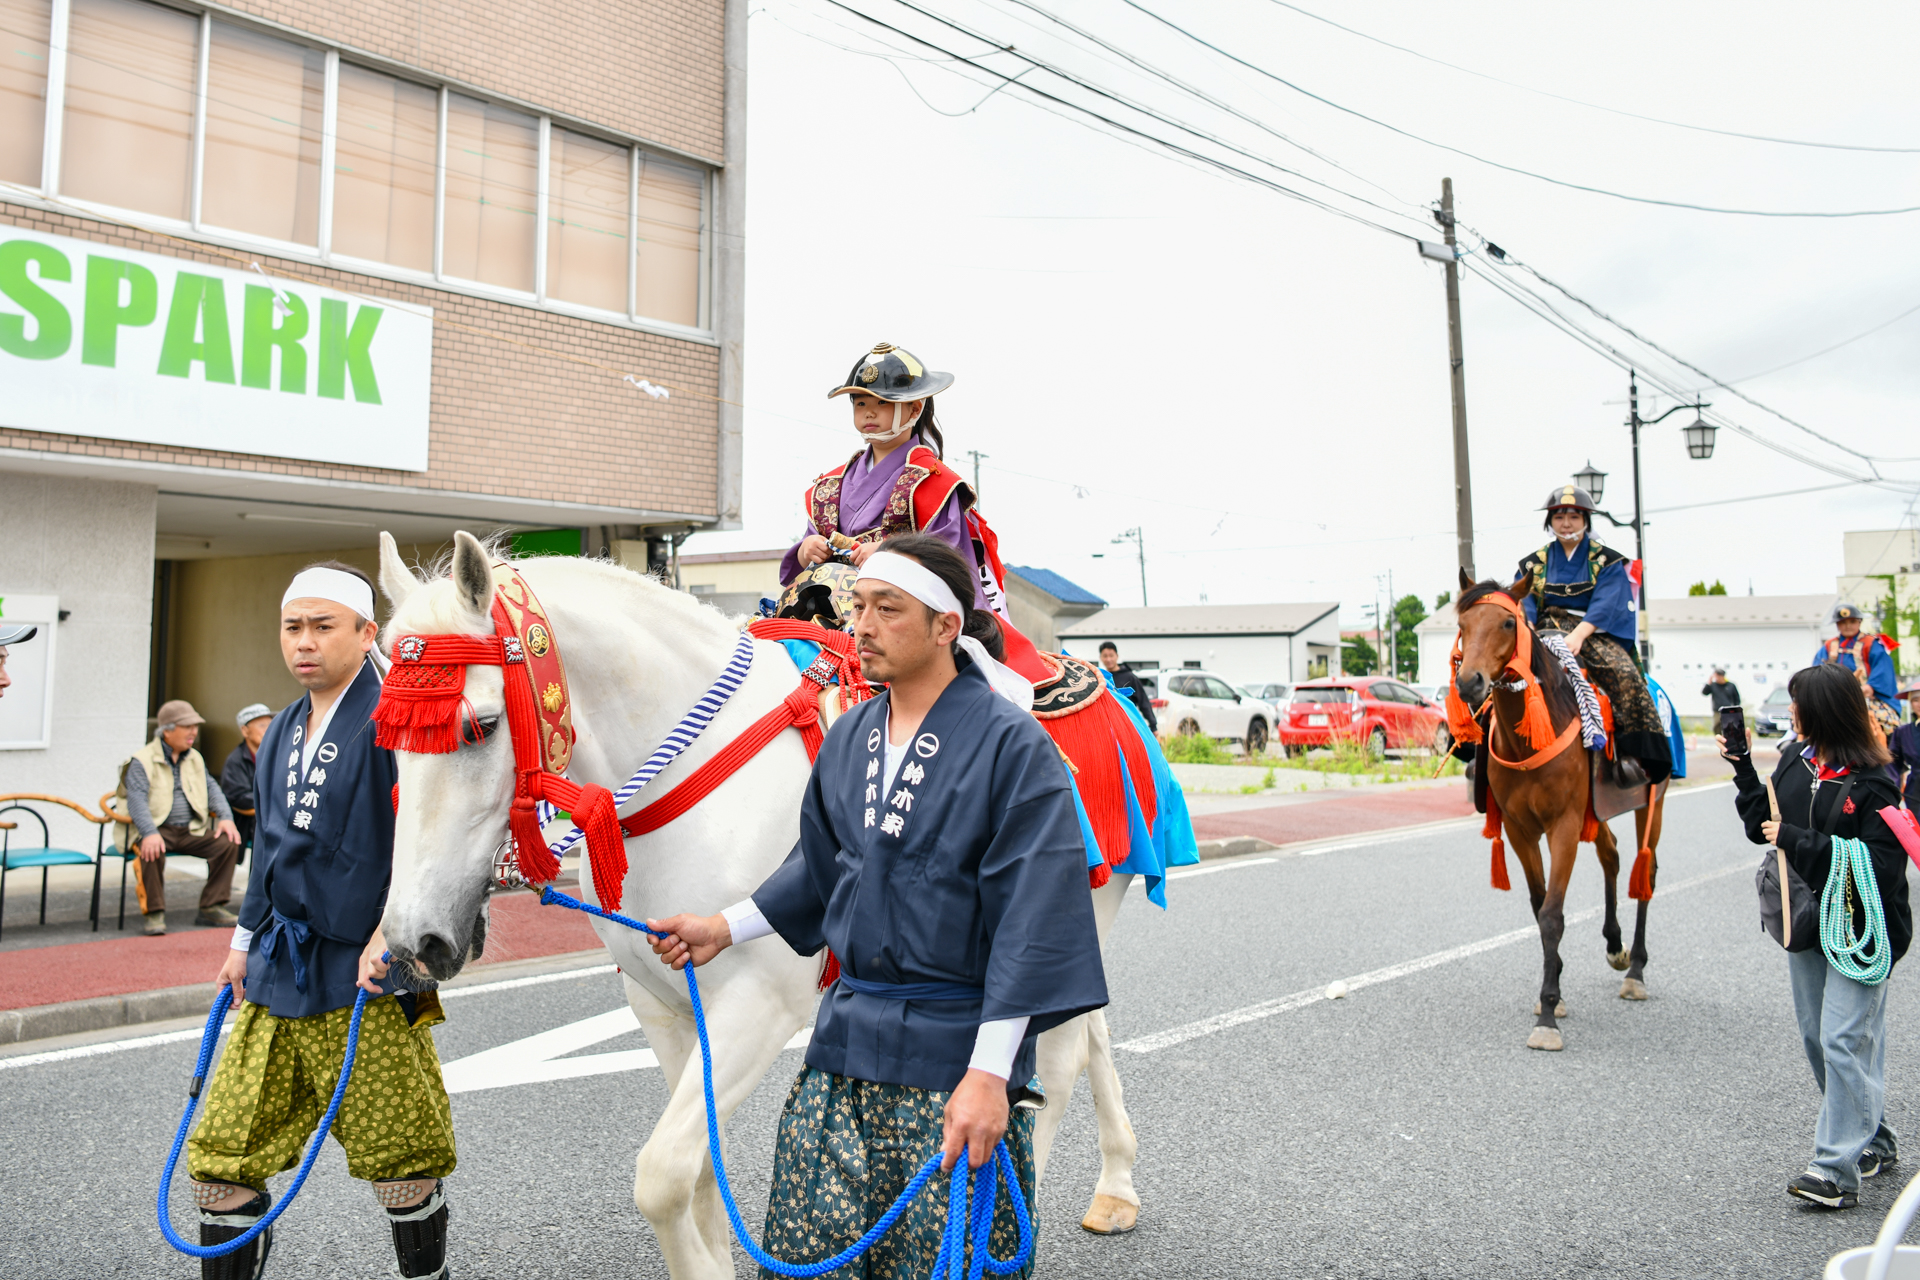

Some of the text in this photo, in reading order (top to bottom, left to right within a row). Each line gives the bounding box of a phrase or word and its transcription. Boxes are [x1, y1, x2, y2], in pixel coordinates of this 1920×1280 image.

[0, 239, 385, 406] SPARK
[293, 766, 327, 831] 鈴木家
[880, 760, 925, 838] 鈴木家
